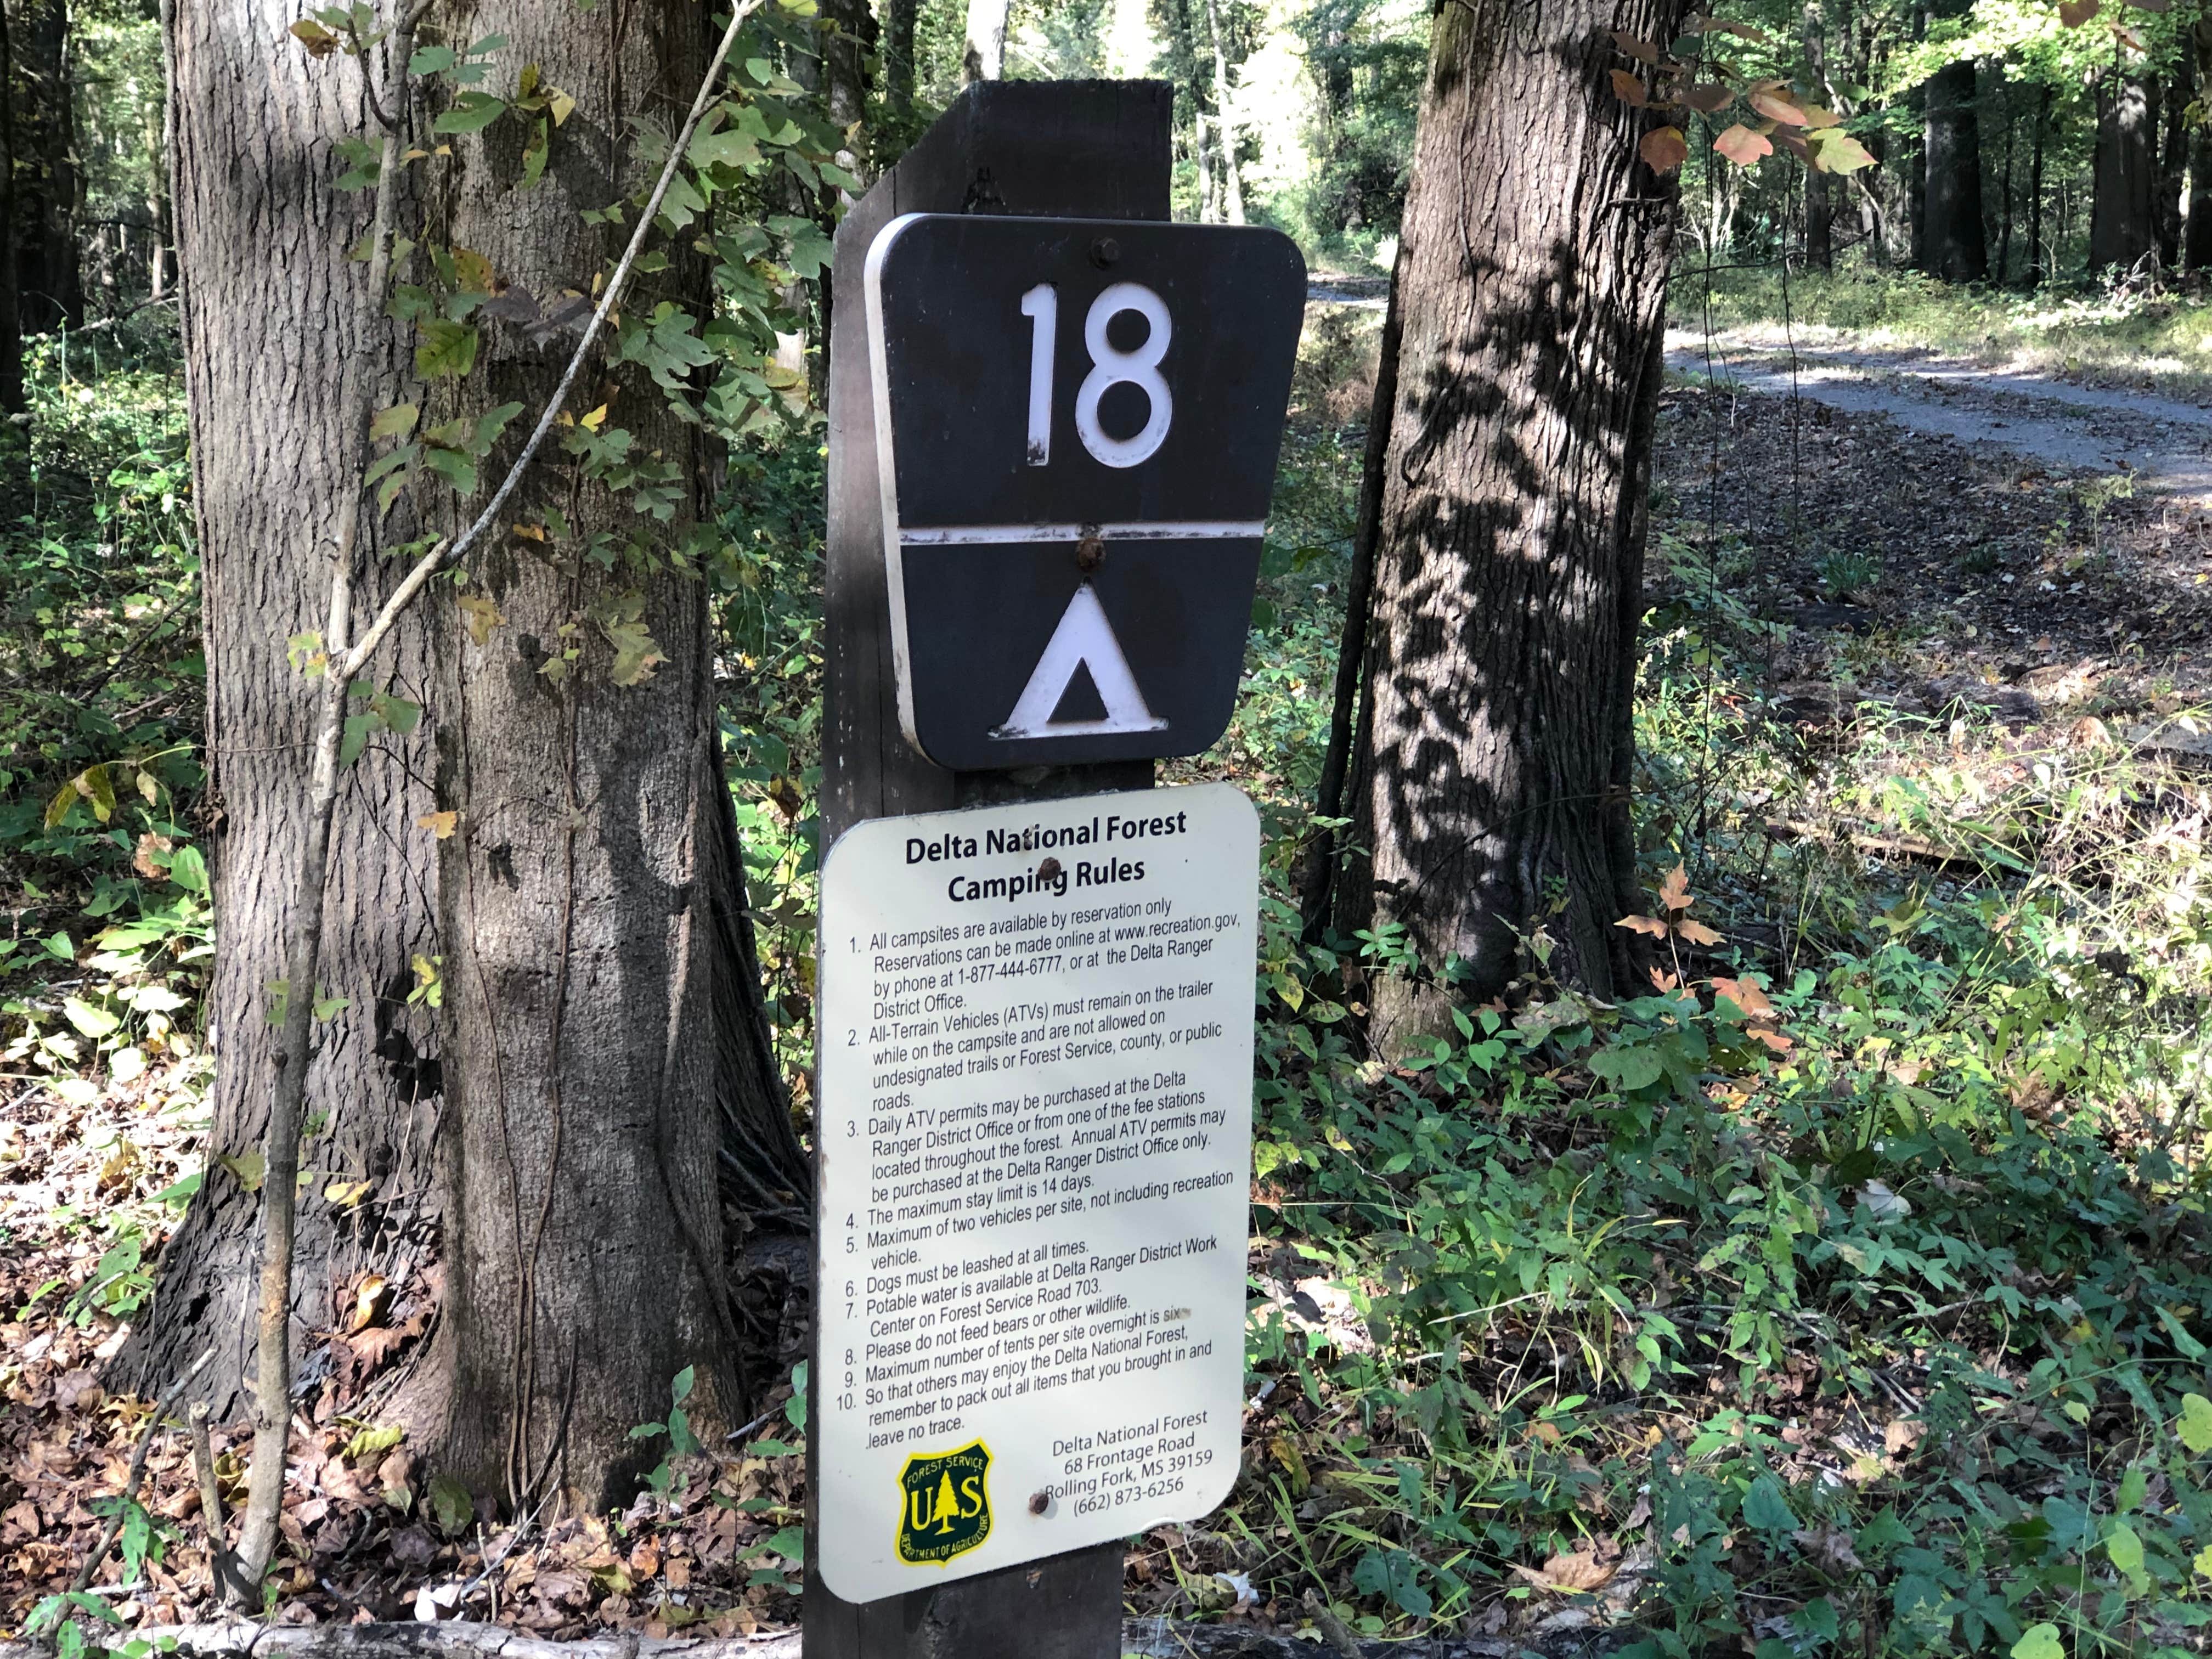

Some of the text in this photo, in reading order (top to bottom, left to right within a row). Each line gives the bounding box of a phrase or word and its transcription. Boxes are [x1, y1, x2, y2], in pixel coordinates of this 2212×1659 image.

[1021, 281, 1172, 468] 18
[906, 810, 1187, 865] Delta National Forest
[948, 856, 1146, 902] Camping Rules
[850, 897, 1172, 953] 1. All campsites are available by reservation only
[874, 913, 1240, 973] Reservations can be made online at www.recreation.gov,
[874, 938, 1214, 1001] by phone at 1-877-444-6777, or at the Delta Ranger
[848, 980, 1214, 1047] 2. All-Terrain Vehicles (ATVs) must remain on the trailer
[874, 992, 967, 1020] District Office.
[873, 1022, 1222, 1089] undesignated trails or Forest Service, county, or public
[847, 1070, 1186, 1138] 3. Daily ATV permits may be purchased at the Delta
[873, 1091, 914, 1112] roads.
[872, 1109, 1226, 1180] located throughout the forest. Annual ATV permits may
[846, 1175, 1094, 1229] 4. The maximum stay limit is 14 days.
[845, 1241, 1089, 1297] 6. Dogs must be leashed at all times.
[845, 1234, 1217, 1319] 7. Potable water is available at Delta Ranger District Work
[845, 1294, 1130, 1365] 8. Please do not feed bears or other wildlife.
[870, 1277, 1102, 1338] Center on Forest Service Road 703.
[837, 1325, 1188, 1411] 10. So that others may enjoy the Delta National Forest,
[869, 1339, 1212, 1427] remember to pack out all items that you brought in and
[1053, 1410, 1207, 1457] Delta National Forest
[1064, 1431, 1195, 1475] 68 Frontage Road
[907, 1456, 984, 1488] FOREST SERVICE
[1045, 1449, 1212, 1499] Rolling Fork, MS 39159
[1074, 1476, 1184, 1517] (662) 873-6256
[901, 1512, 989, 1559] DEPARTMENT OF AGRICULTURE
